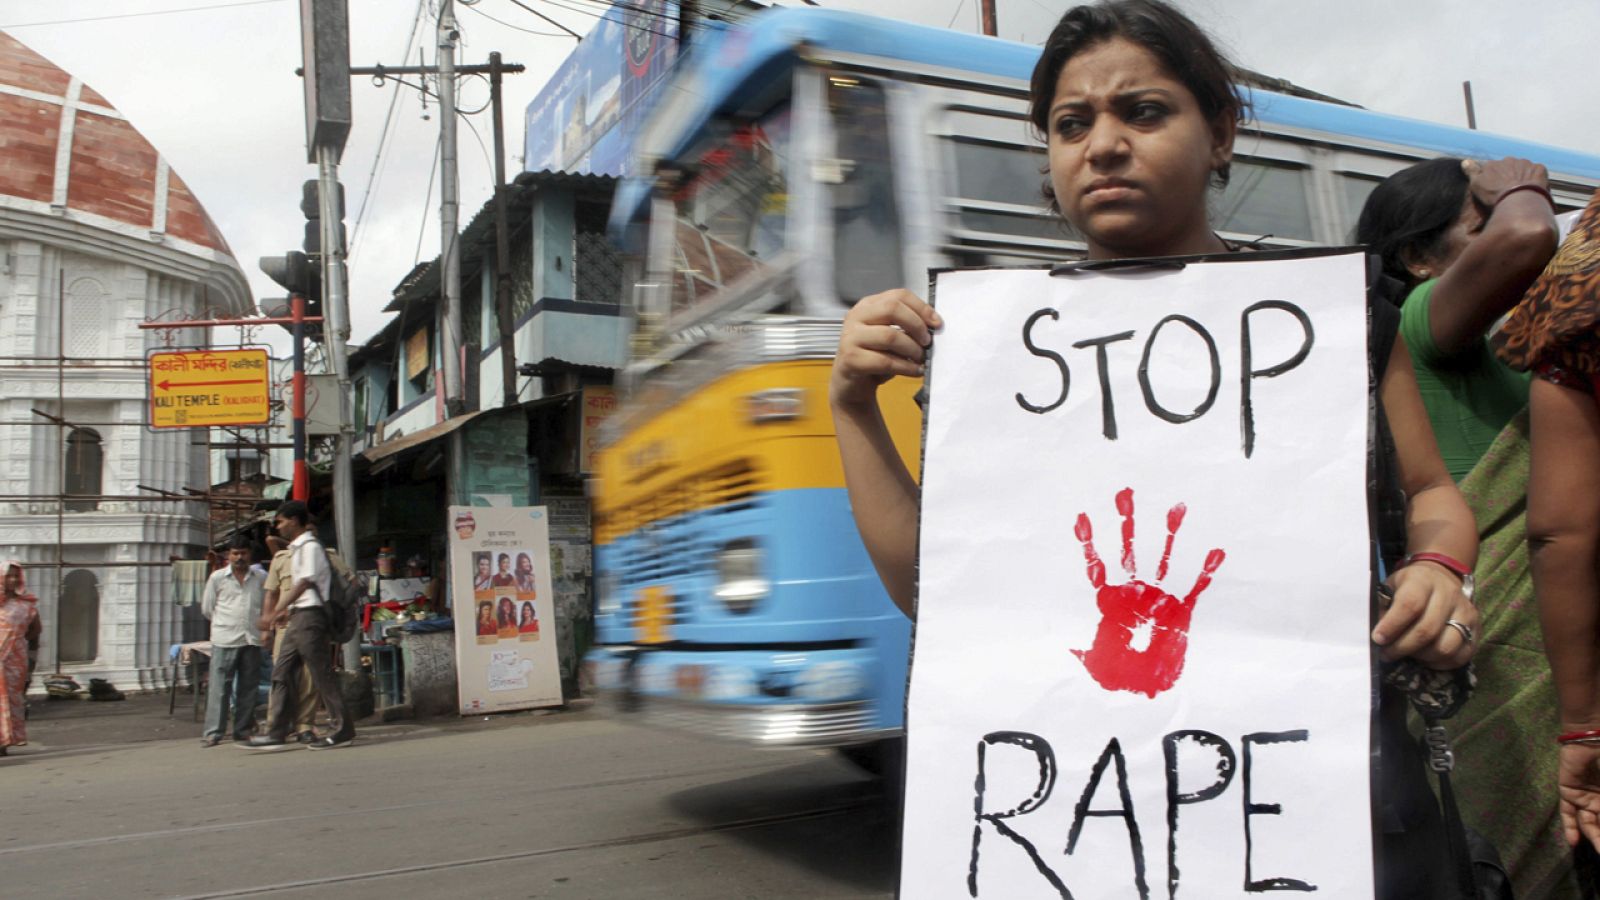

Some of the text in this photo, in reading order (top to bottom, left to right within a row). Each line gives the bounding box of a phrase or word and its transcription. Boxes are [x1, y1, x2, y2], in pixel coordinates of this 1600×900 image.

[155, 396, 174, 408] KALI
[176, 394, 220, 407] TEMPLE
[1014, 299, 1315, 459] STOP
[966, 729, 1318, 900] RAPE
